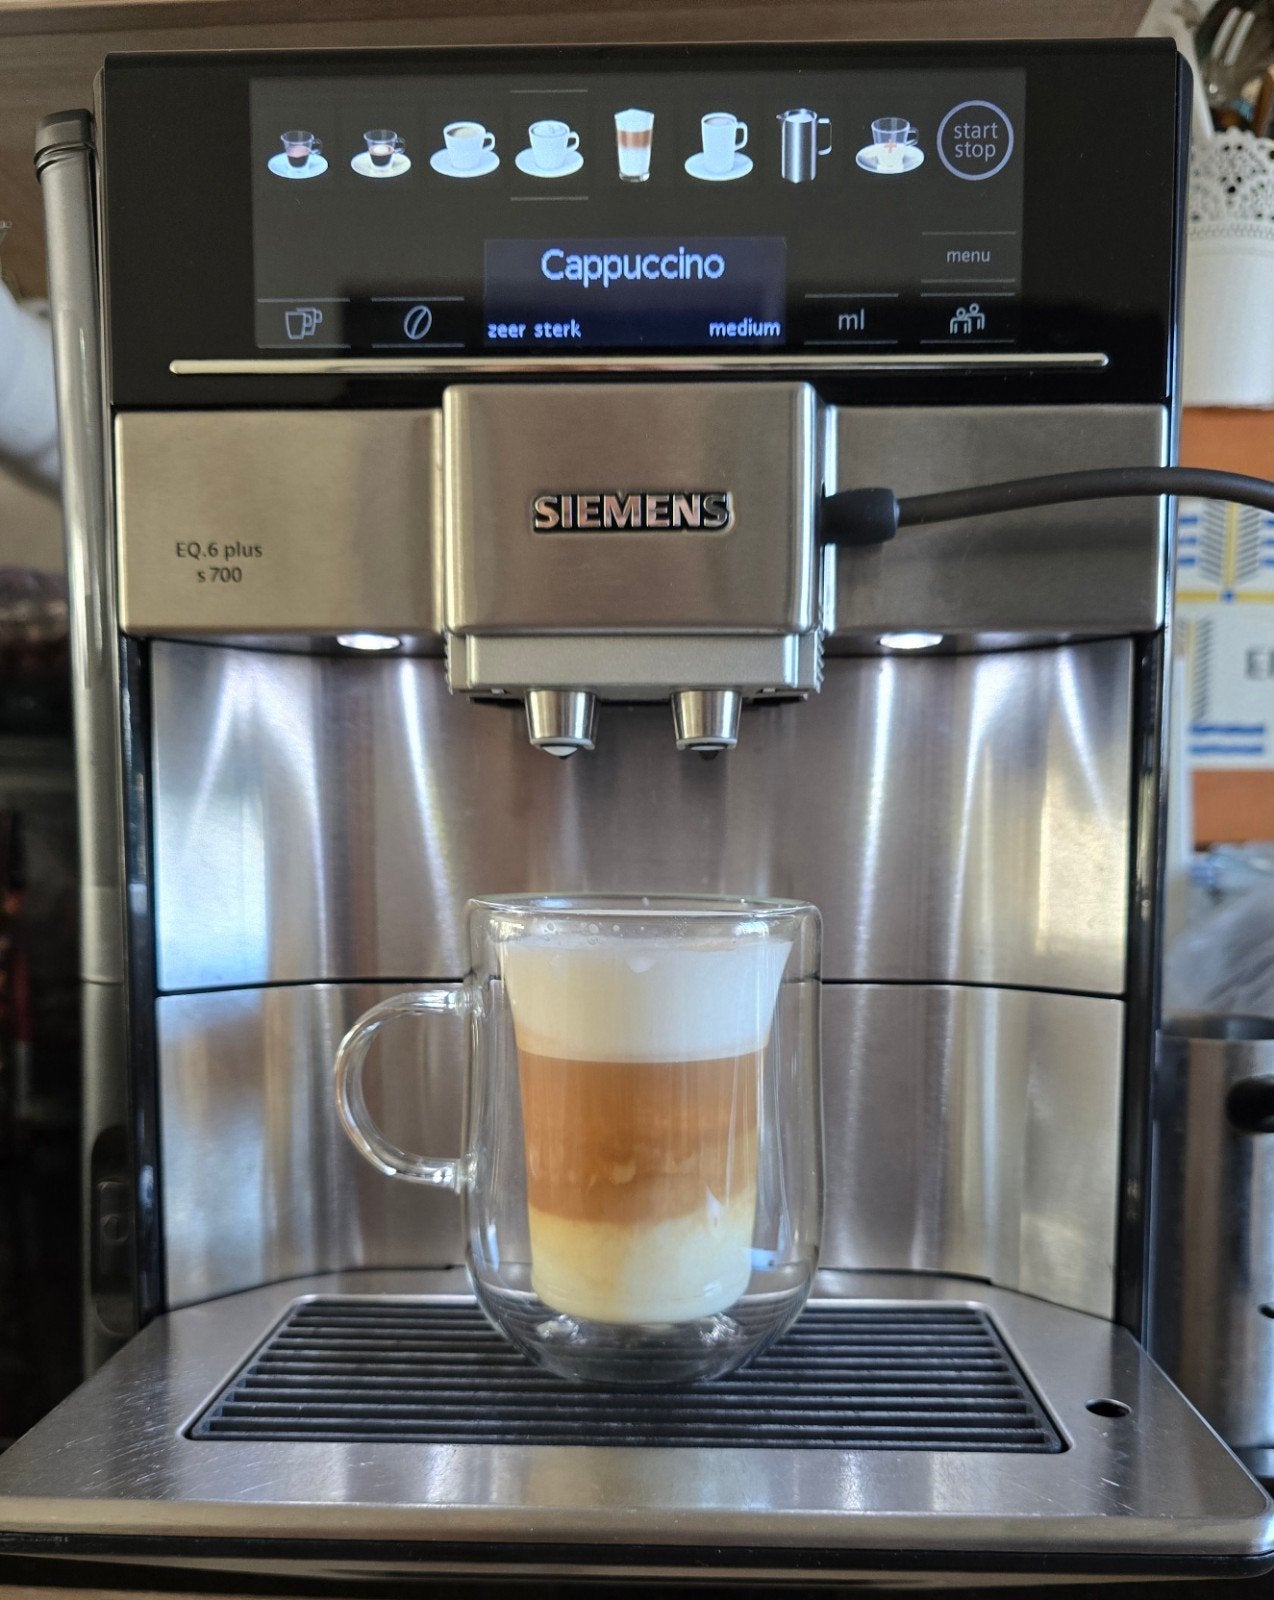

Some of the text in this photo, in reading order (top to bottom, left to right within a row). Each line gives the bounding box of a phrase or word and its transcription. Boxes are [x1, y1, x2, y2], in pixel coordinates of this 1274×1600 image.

[954, 123, 998, 139] start
[955, 141, 996, 161] stop
[946, 250, 991, 263] menu
[540, 246, 726, 288] Cappuccino
[487, 319, 582, 338] zeer sterk
[708, 318, 782, 337] medium
[838, 308, 865, 331] ml
[533, 493, 734, 530] SIEMENS
[176, 541, 263, 561] EQ.6 plus
[197, 567, 242, 583] s 700
